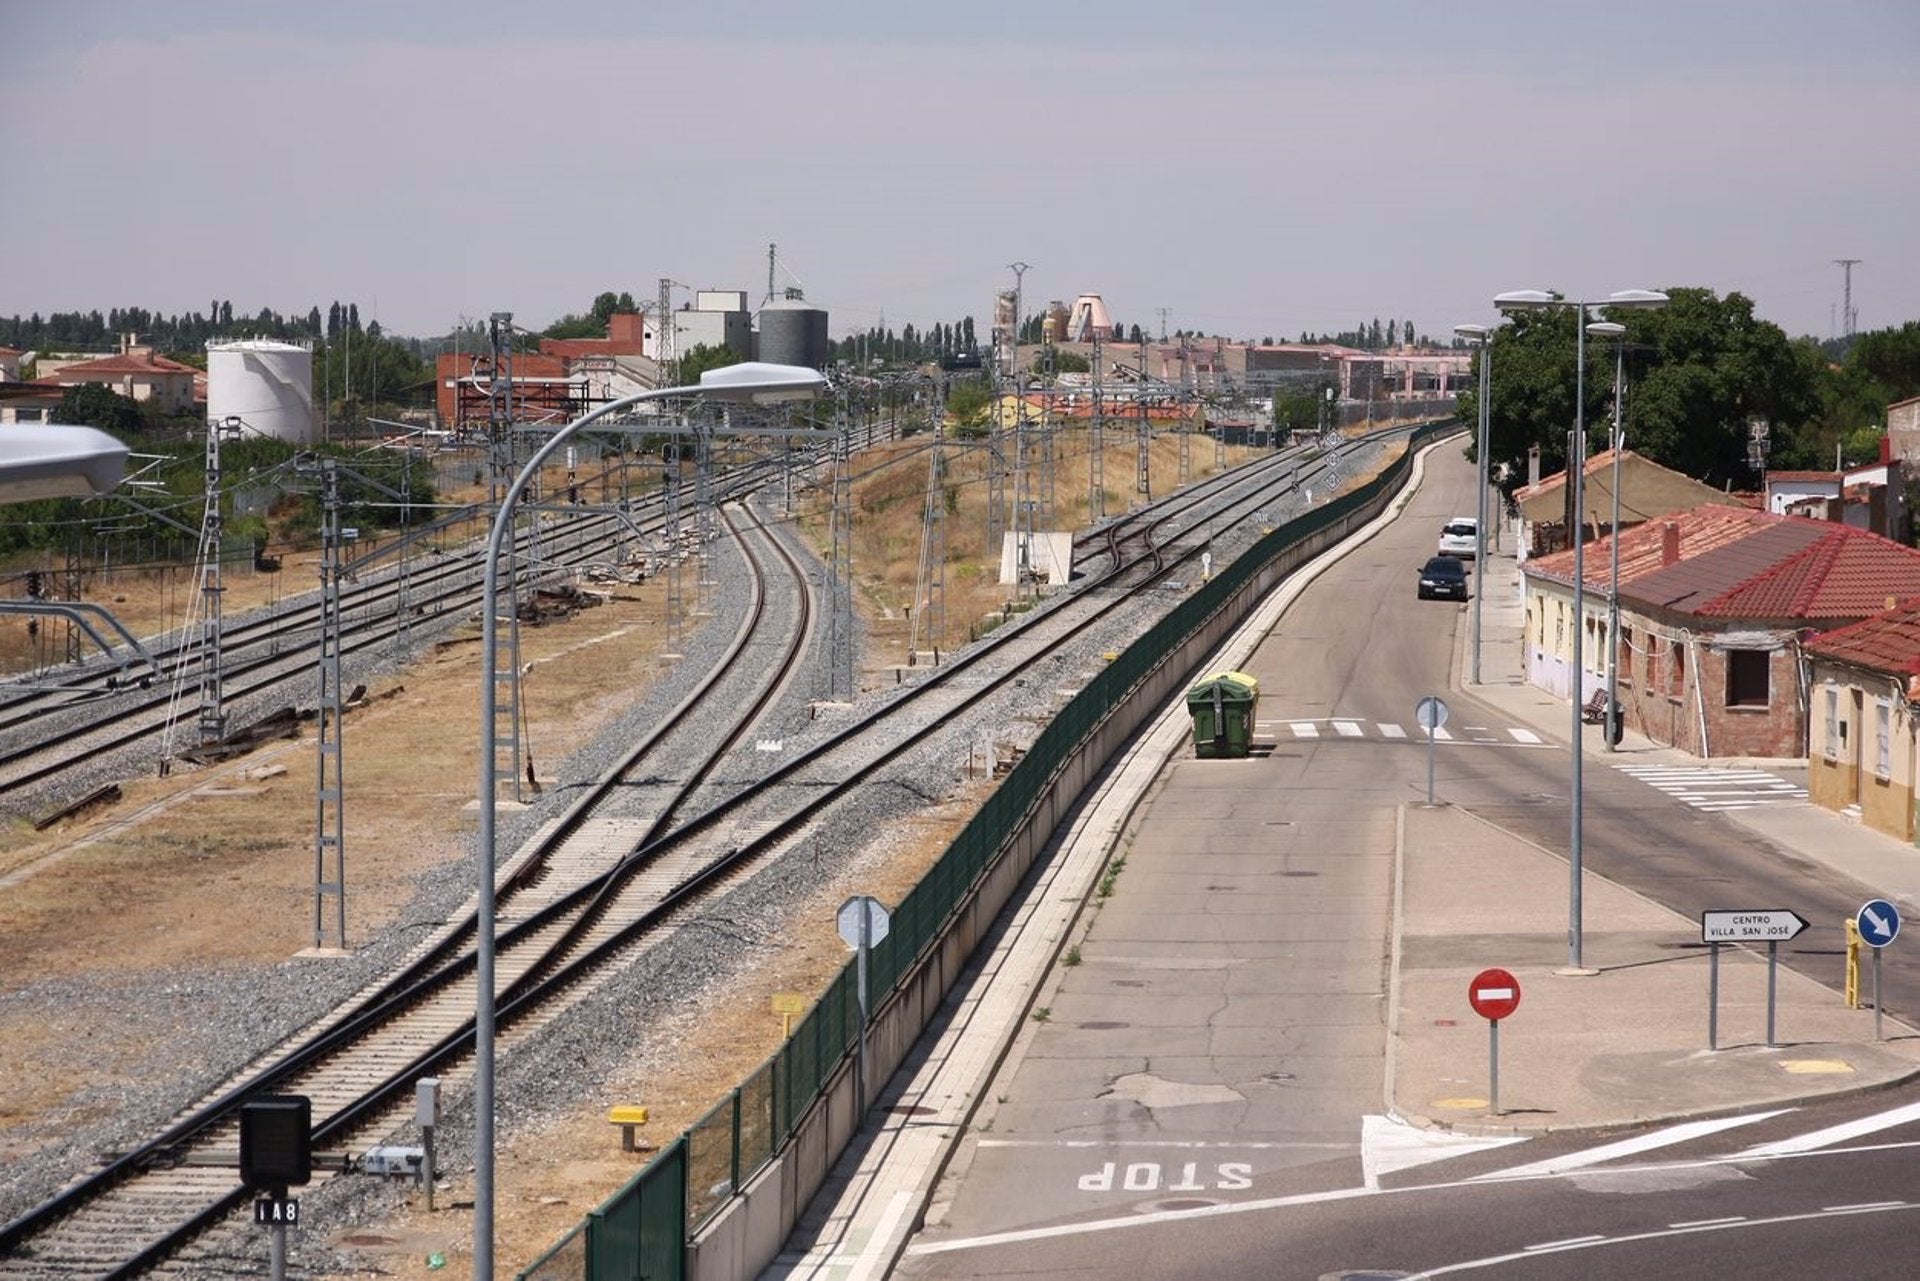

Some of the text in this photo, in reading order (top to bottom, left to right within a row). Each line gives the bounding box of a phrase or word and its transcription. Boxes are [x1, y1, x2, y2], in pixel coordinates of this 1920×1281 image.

[1733, 916, 1770, 924] CENTRO
[1711, 925, 1789, 936] VILLA SAN JOSÉ
[1078, 1162, 1252, 1191] STOP
